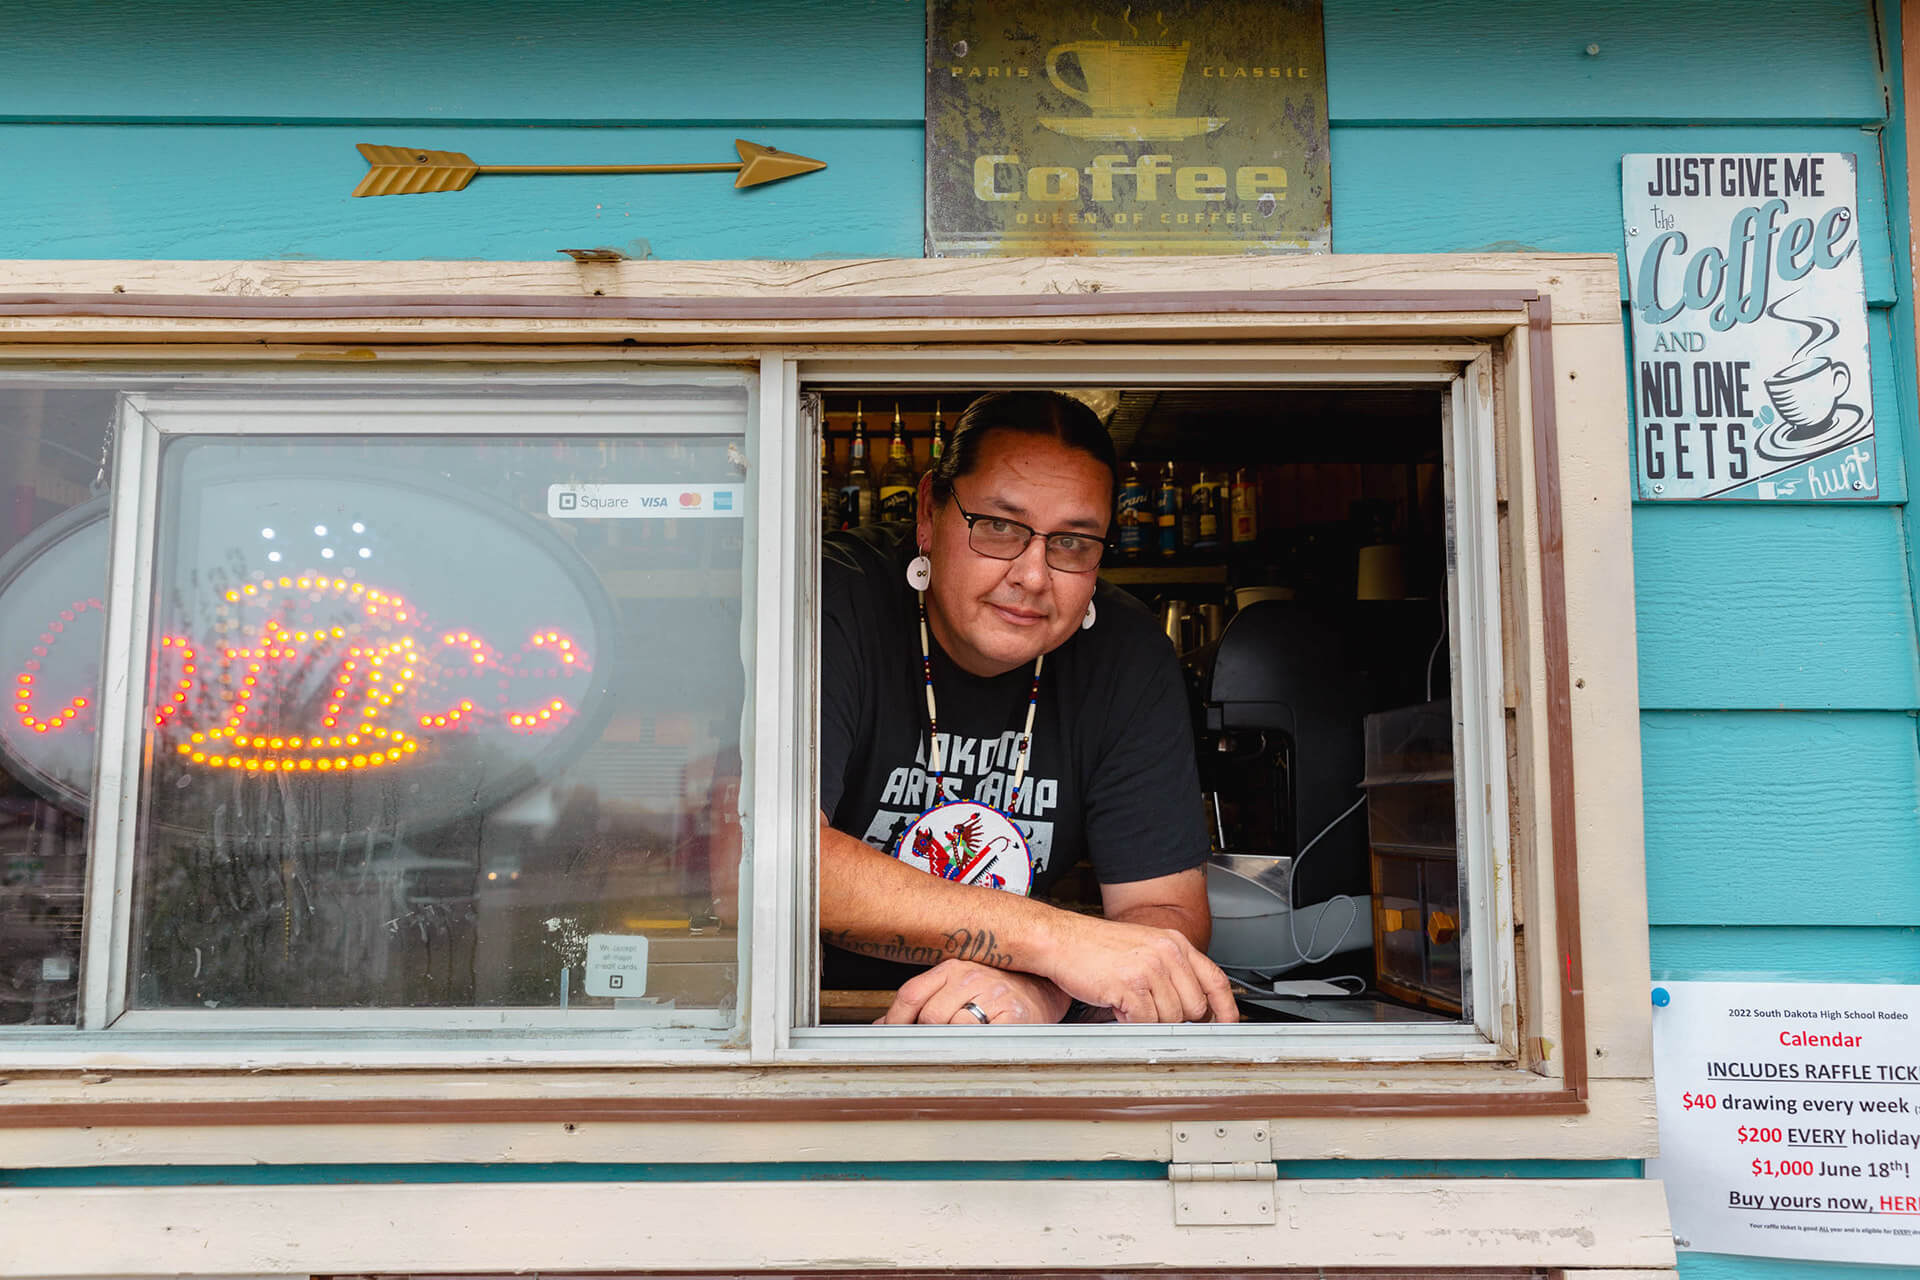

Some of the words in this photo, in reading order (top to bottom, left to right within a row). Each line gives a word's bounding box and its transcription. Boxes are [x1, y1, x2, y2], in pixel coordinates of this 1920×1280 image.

[951, 66, 1031, 78] PARIS
[1202, 66, 1310, 79] CLASSIC
[973, 154, 1289, 201] Coffee
[1648, 158, 1715, 197] JUST
[1720, 158, 1778, 197] GIVE
[1784, 158, 1825, 197] ME
[1015, 212, 1097, 224] QUEEN
[1114, 212, 1144, 224] OF
[1160, 212, 1254, 224] COFFEE
[1650, 204, 1675, 231] the
[1637, 198, 1858, 332] Coffee
[1654, 331, 1707, 353] AND
[1641, 361, 1683, 418] NO
[1692, 361, 1754, 418] ONE
[1644, 423, 1749, 480] GETS
[1807, 446, 1877, 498] hurt
[580, 495, 629, 511] Square
[640, 497, 668, 507] VISA
[1728, 1008, 1752, 1018] 2022
[1754, 1008, 1781, 1018] South
[1784, 1009, 1818, 1019] Dakota
[1820, 1010, 1842, 1021] High
[1844, 1010, 1876, 1020] School
[1878, 1010, 1909, 1021] Rodeo
[1779, 1031, 1863, 1048] Calendar
[1707, 1062, 1799, 1079] INCLUDES
[1805, 1064, 1872, 1080] RAFFLE
[1876, 1065, 1920, 1081] TICK
[1682, 1092, 1717, 1111] $40
[1722, 1094, 1798, 1114] drawing
[1802, 1099, 1854, 1115] every
[1859, 1097, 1910, 1113] week
[1737, 1125, 1783, 1144] $200
[1787, 1128, 1847, 1145] EVERY
[1852, 1128, 1920, 1150] holiday
[1752, 1158, 1814, 1178] $1,000
[1818, 1161, 1862, 1178] June
[1868, 1160, 1910, 1178] 18th!
[1729, 1191, 1764, 1210] Buy
[1769, 1197, 1822, 1210] yours
[1828, 1198, 1875, 1213] now,
